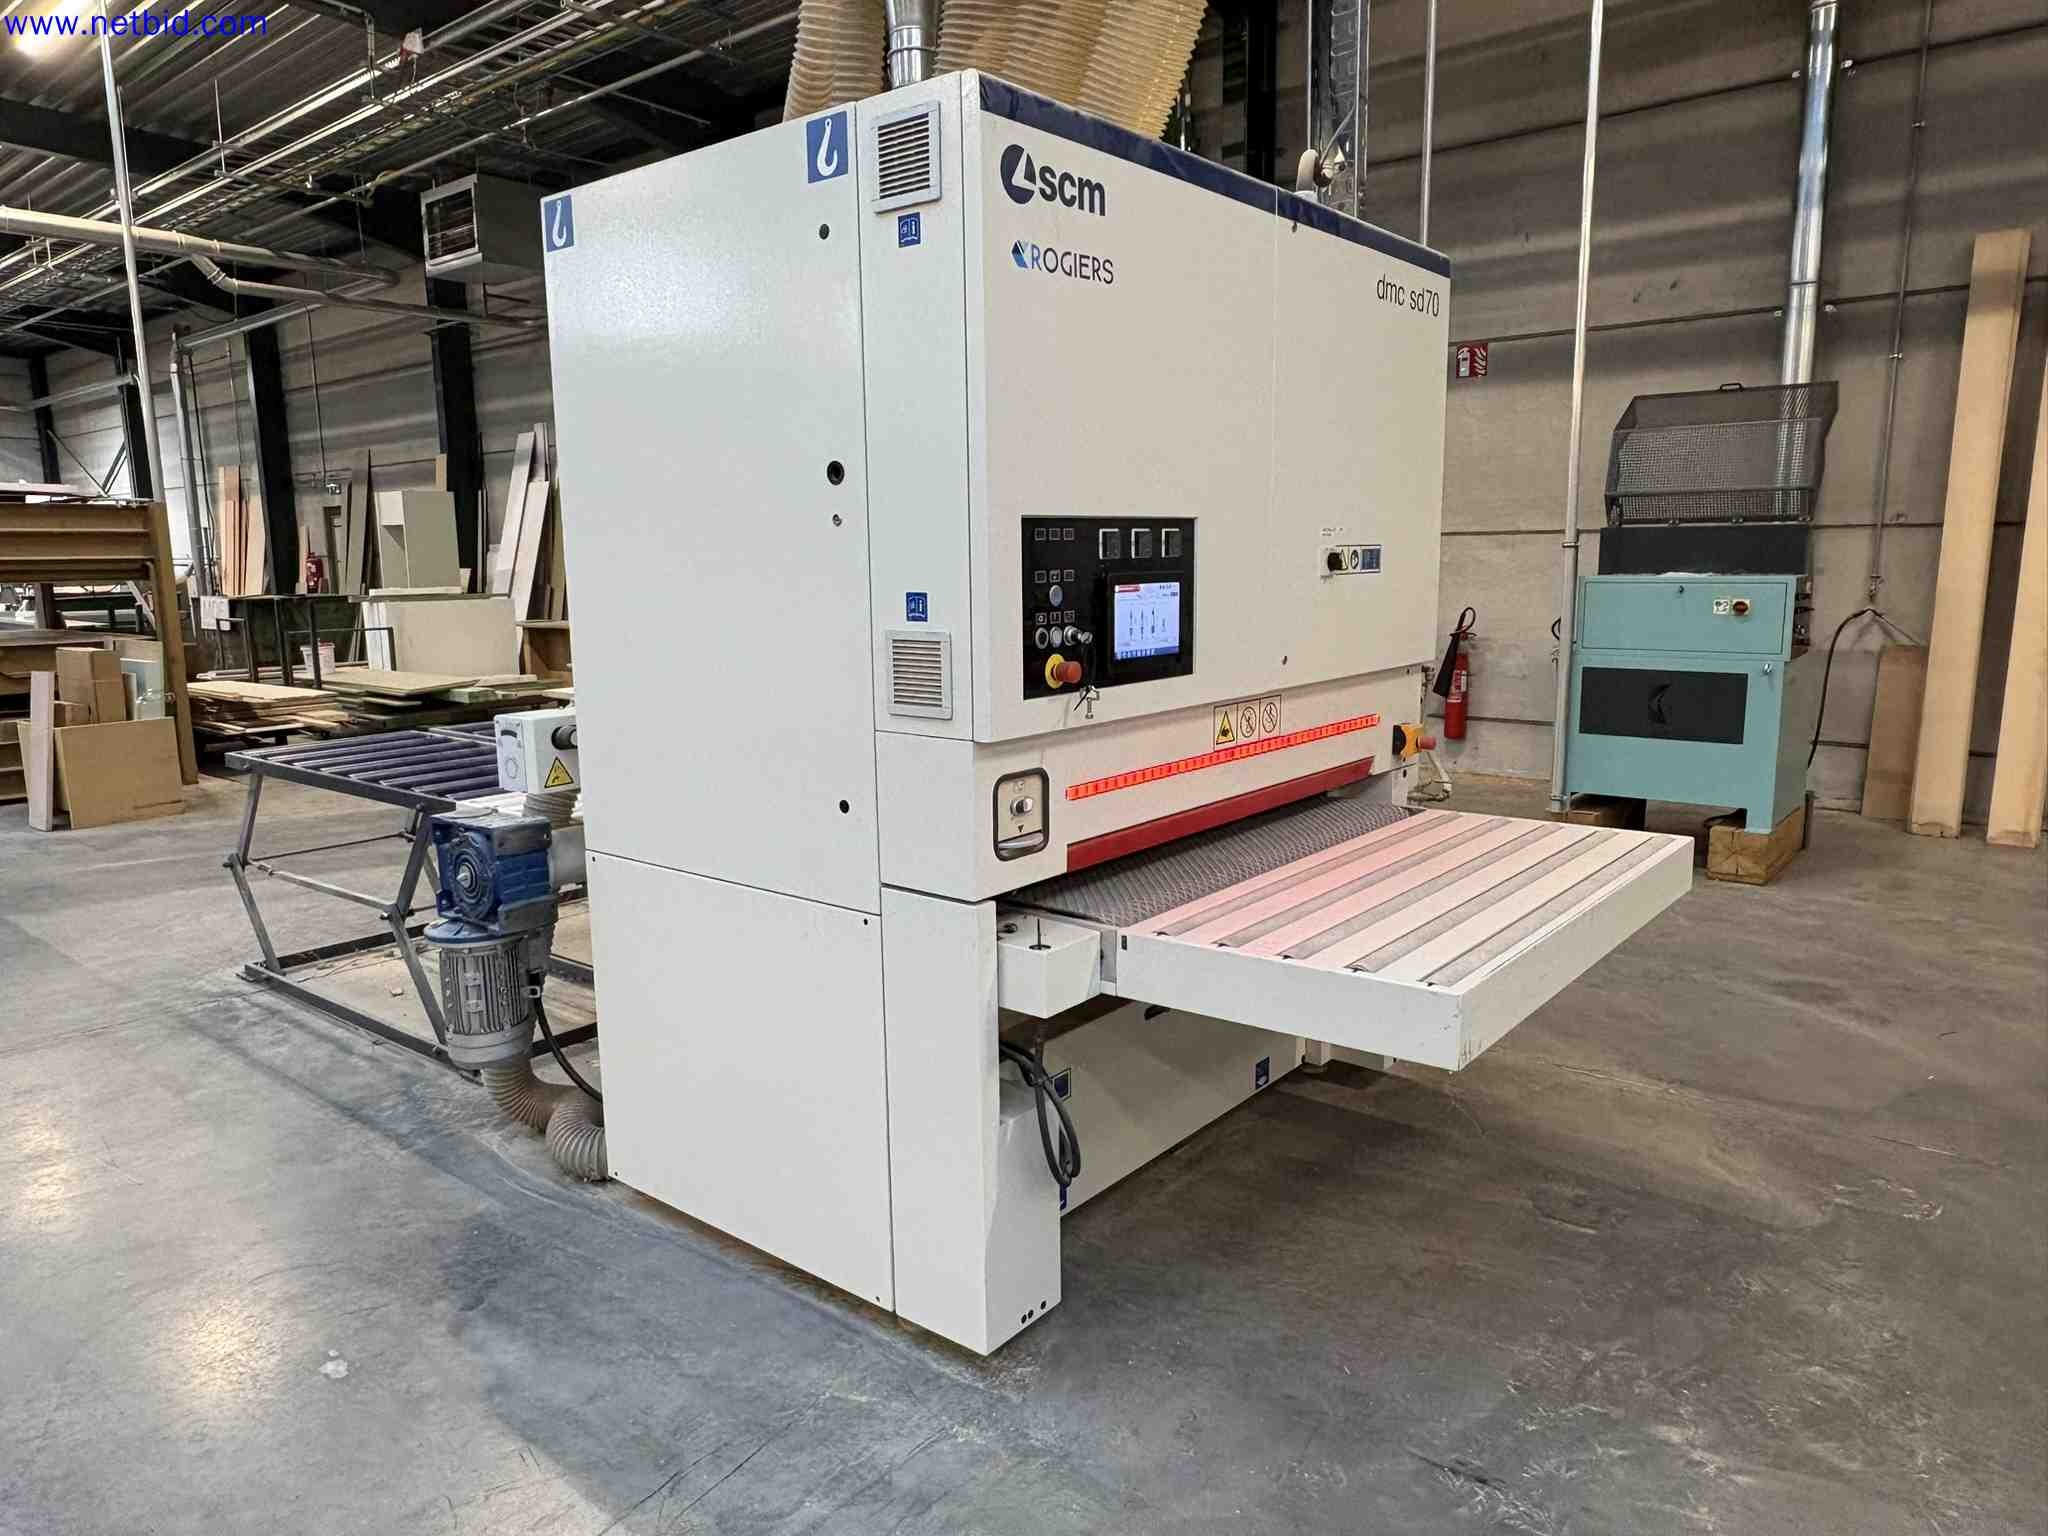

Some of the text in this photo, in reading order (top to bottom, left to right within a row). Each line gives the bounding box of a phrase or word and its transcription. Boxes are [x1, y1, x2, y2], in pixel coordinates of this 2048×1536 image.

[1038, 165, 1106, 217] scm
[1030, 243, 1115, 285] ROGIERS
[1376, 273, 1440, 317] dmc sd70
